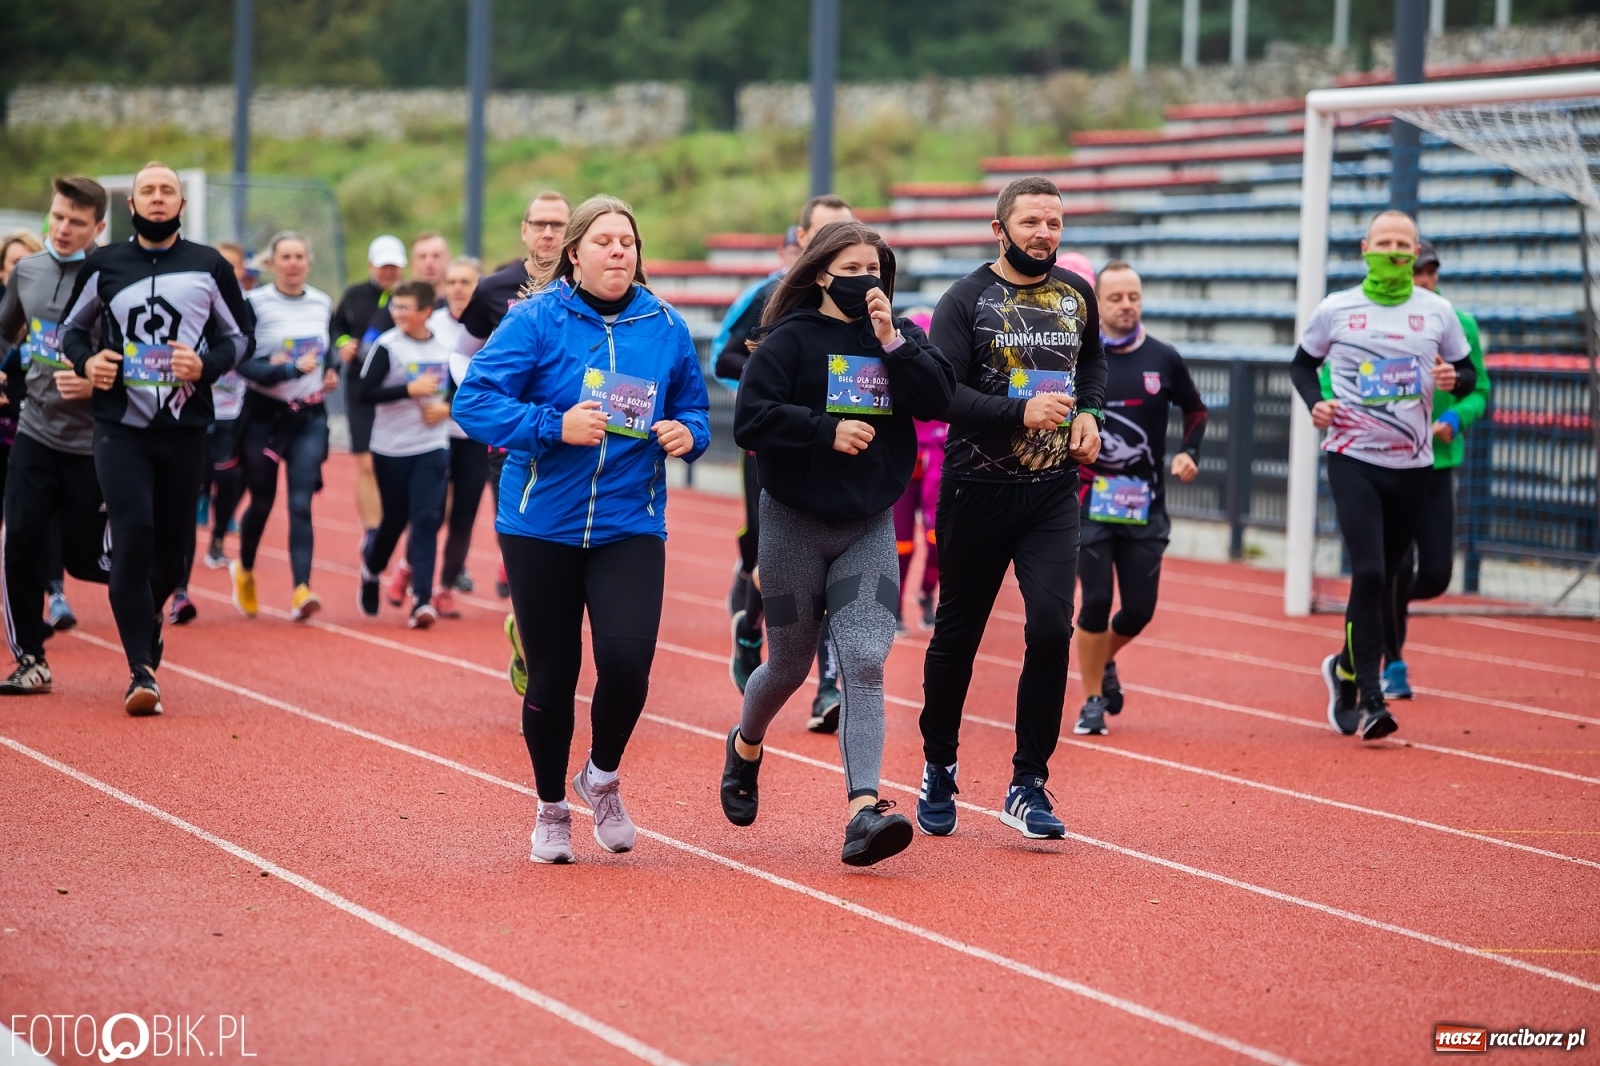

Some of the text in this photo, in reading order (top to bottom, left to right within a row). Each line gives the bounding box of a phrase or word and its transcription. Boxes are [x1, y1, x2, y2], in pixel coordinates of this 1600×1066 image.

[995, 331, 1080, 348] RUNMAGEDDON
[838, 375, 854, 383] BIEG
[856, 376, 869, 384] DLA
[591, 389, 607, 399] BIEG
[610, 394, 624, 402] DLA
[1018, 388, 1033, 397] BIEG
[873, 396, 890, 407] 213
[625, 417, 645, 430] 211
